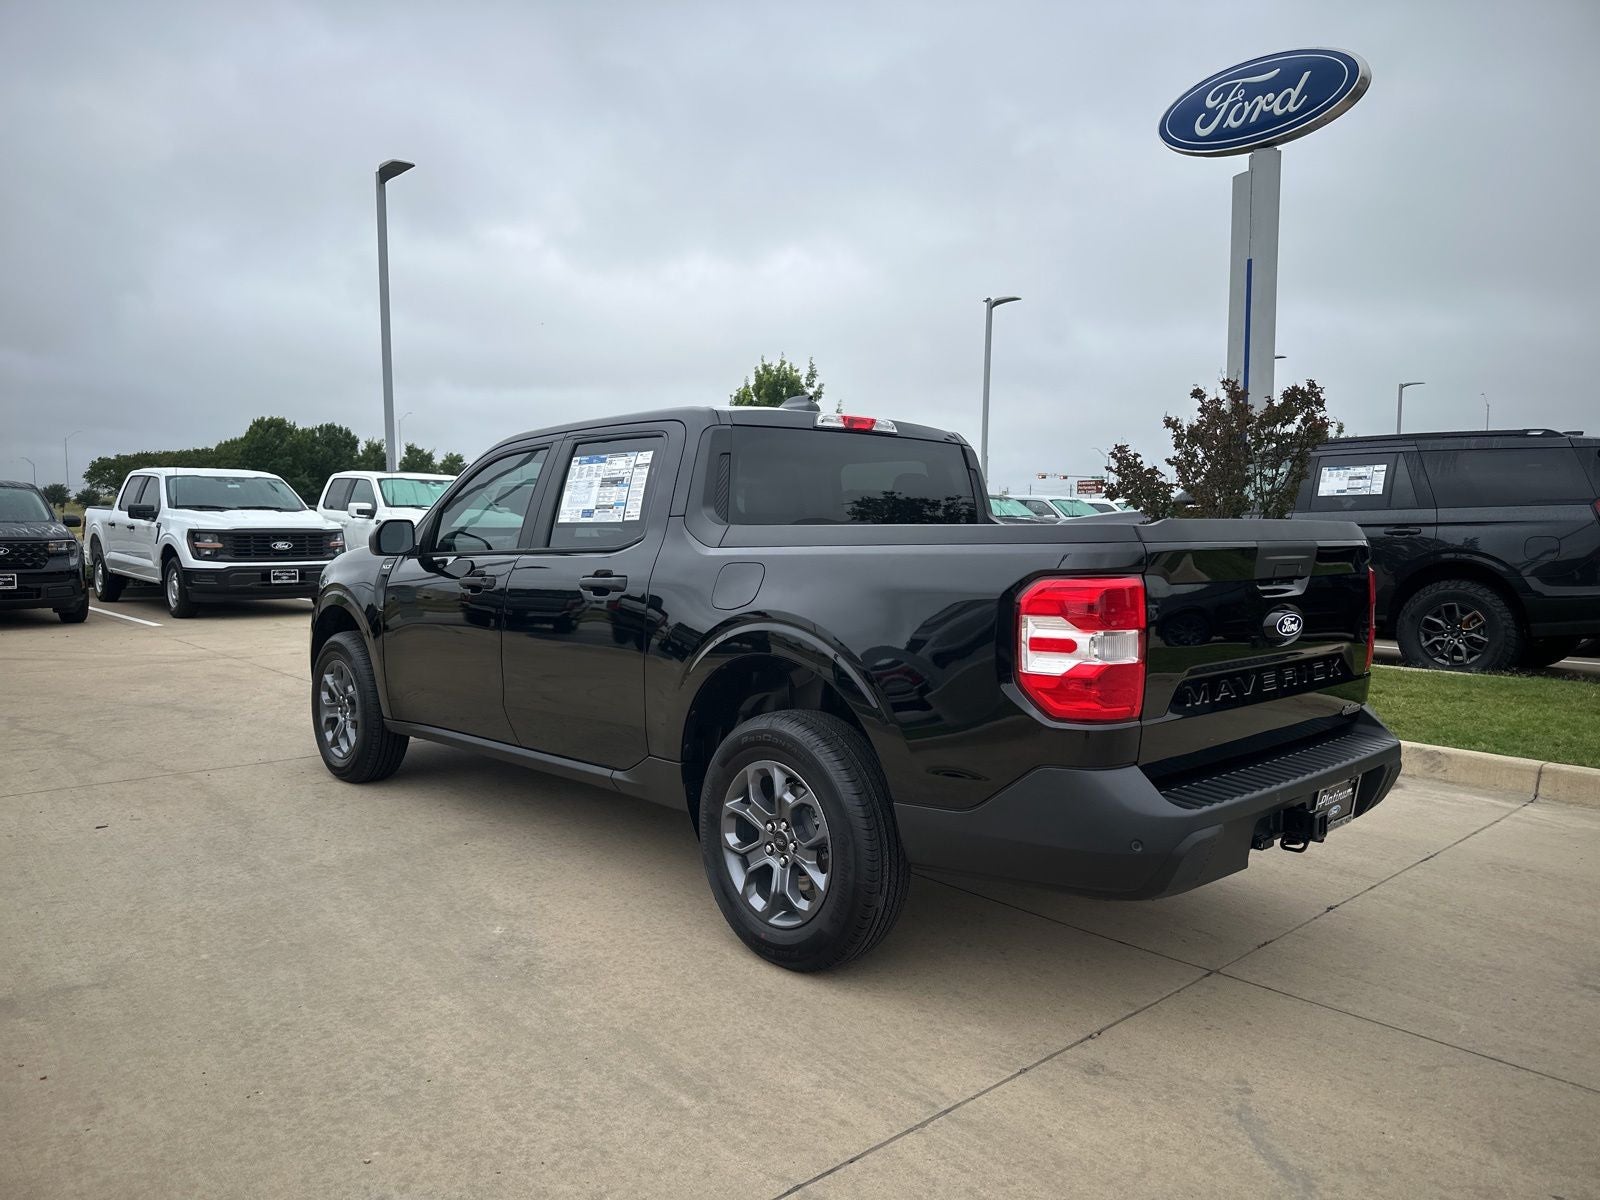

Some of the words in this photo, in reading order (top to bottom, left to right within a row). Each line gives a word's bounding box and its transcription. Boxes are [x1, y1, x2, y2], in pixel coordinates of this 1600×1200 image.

[1194, 68, 1312, 137] Ford
[1281, 616, 1299, 633] Ford
[1184, 658, 1343, 708] MAVERICK
[1317, 787, 1353, 808] Platinum
